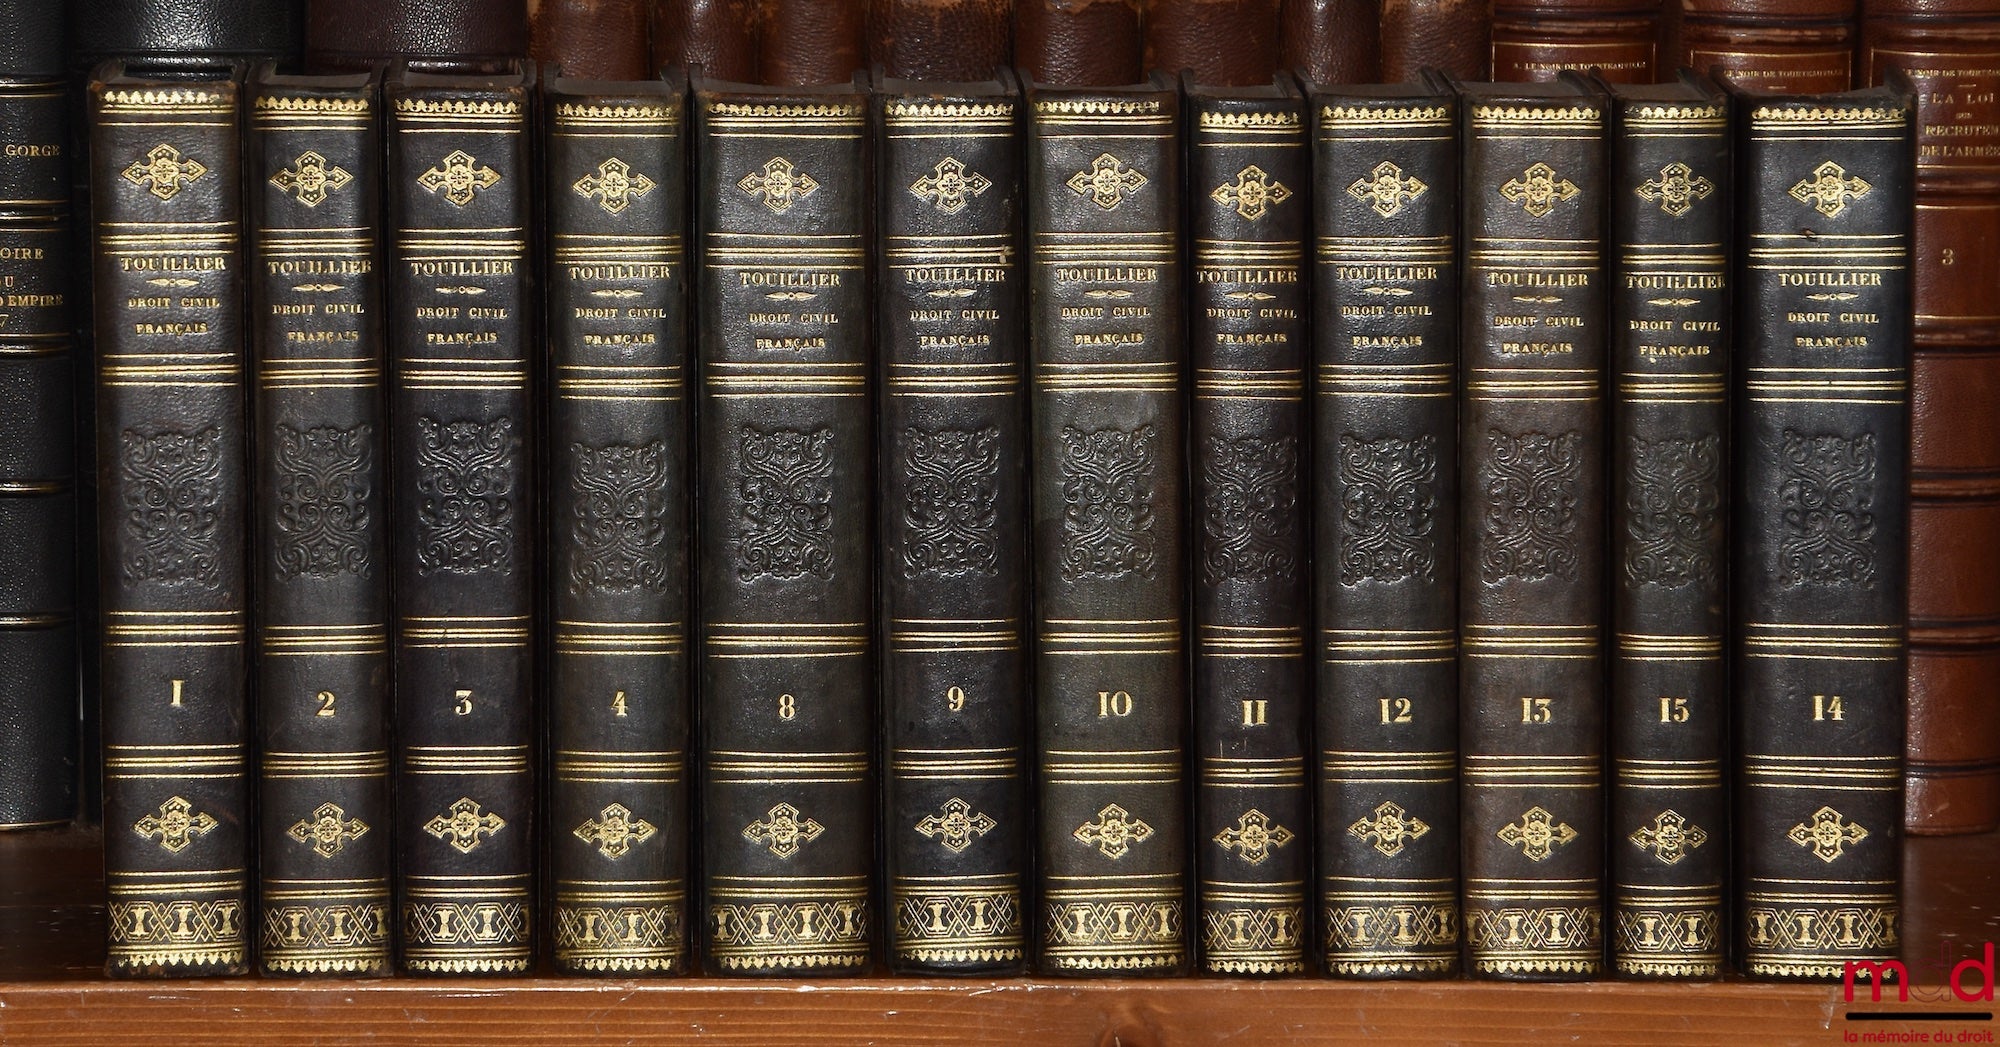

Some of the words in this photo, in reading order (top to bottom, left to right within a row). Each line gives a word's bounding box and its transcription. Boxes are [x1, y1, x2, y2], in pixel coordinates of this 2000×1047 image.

[1931, 93, 1954, 104] LA
[1967, 93, 1994, 104] LOI
[5, 144, 60, 156] GORGE
[1921, 145, 1939, 156] DE
[121, 256, 226, 271] TOUILLIER
[1942, 248, 1954, 265] 3
[269, 260, 372, 275] TOUILLIER
[411, 261, 514, 276] TOUILLIER
[569, 265, 670, 281] TOUILLIER
[1057, 267, 1157, 282] TOUILLIER
[1337, 266, 1437, 280] TOUILLIER
[740, 272, 840, 287] TOUILLIER
[905, 269, 1005, 283] TOUILLIER
[1197, 270, 1297, 284] TOUILLIER
[1488, 272, 1588, 286] TOUILLIER
[1625, 275, 1725, 290] TOUILLIER
[1779, 273, 1881, 287] TOUILLIER
[8, 295, 63, 307] EMPIRE
[128, 297, 171, 309] DROIT
[181, 297, 220, 309] CIVIL
[272, 303, 315, 315] DROIT
[325, 303, 365, 315] CIVIL
[417, 307, 460, 318] DROIT
[469, 307, 508, 318] CIVIL
[576, 308, 617, 319] DROIT
[628, 308, 667, 319] CIVIL
[910, 309, 952, 321] DROIT
[962, 309, 999, 321] CIVIL
[1062, 307, 1104, 318] DROIT
[1113, 307, 1150, 318] CIVIL
[1207, 307, 1252, 319] DROIT
[1259, 307, 1297, 319] CIVIL
[1342, 305, 1384, 316] DROIT
[1394, 305, 1432, 316] CIVIL
[749, 313, 791, 324] DROIT
[800, 313, 839, 324] CIVIL
[1494, 316, 1537, 327] DROIT
[1545, 316, 1584, 327] CIVIL
[1787, 312, 1830, 323] DROIT
[1840, 312, 1879, 323] CIVIL
[136, 323, 208, 336] FRANÇAIS
[1630, 320, 1672, 331] DROIT
[1683, 320, 1720, 331] CIVIL
[288, 330, 359, 343] FRANÇAIS
[427, 332, 497, 346] FRANÇAIS
[584, 333, 656, 346] FRANÇAIS
[756, 336, 825, 350] FRANÇAIS
[920, 334, 990, 347] FRANÇAIS
[1074, 333, 1144, 345] FRANÇAIS
[1217, 333, 1287, 345] FRANÇAIS
[1353, 336, 1423, 349] FRANÇAIS
[1796, 337, 1867, 350] FRANÇAIS
[1503, 343, 1573, 356] FRANÇAIS
[1640, 345, 1710, 358] FRANÇAIS
[171, 679, 183, 706] 1
[947, 685, 965, 712] 9
[316, 691, 336, 717] 2
[455, 689, 472, 716] 3
[610, 691, 628, 717] 4
[778, 694, 796, 720] 8
[1097, 690, 1132, 717] 10
[1813, 695, 1845, 721] 14
[1242, 699, 1268, 726] 11
[1379, 697, 1412, 724] 12
[1521, 697, 1551, 724] 13
[1660, 697, 1690, 724] 15
